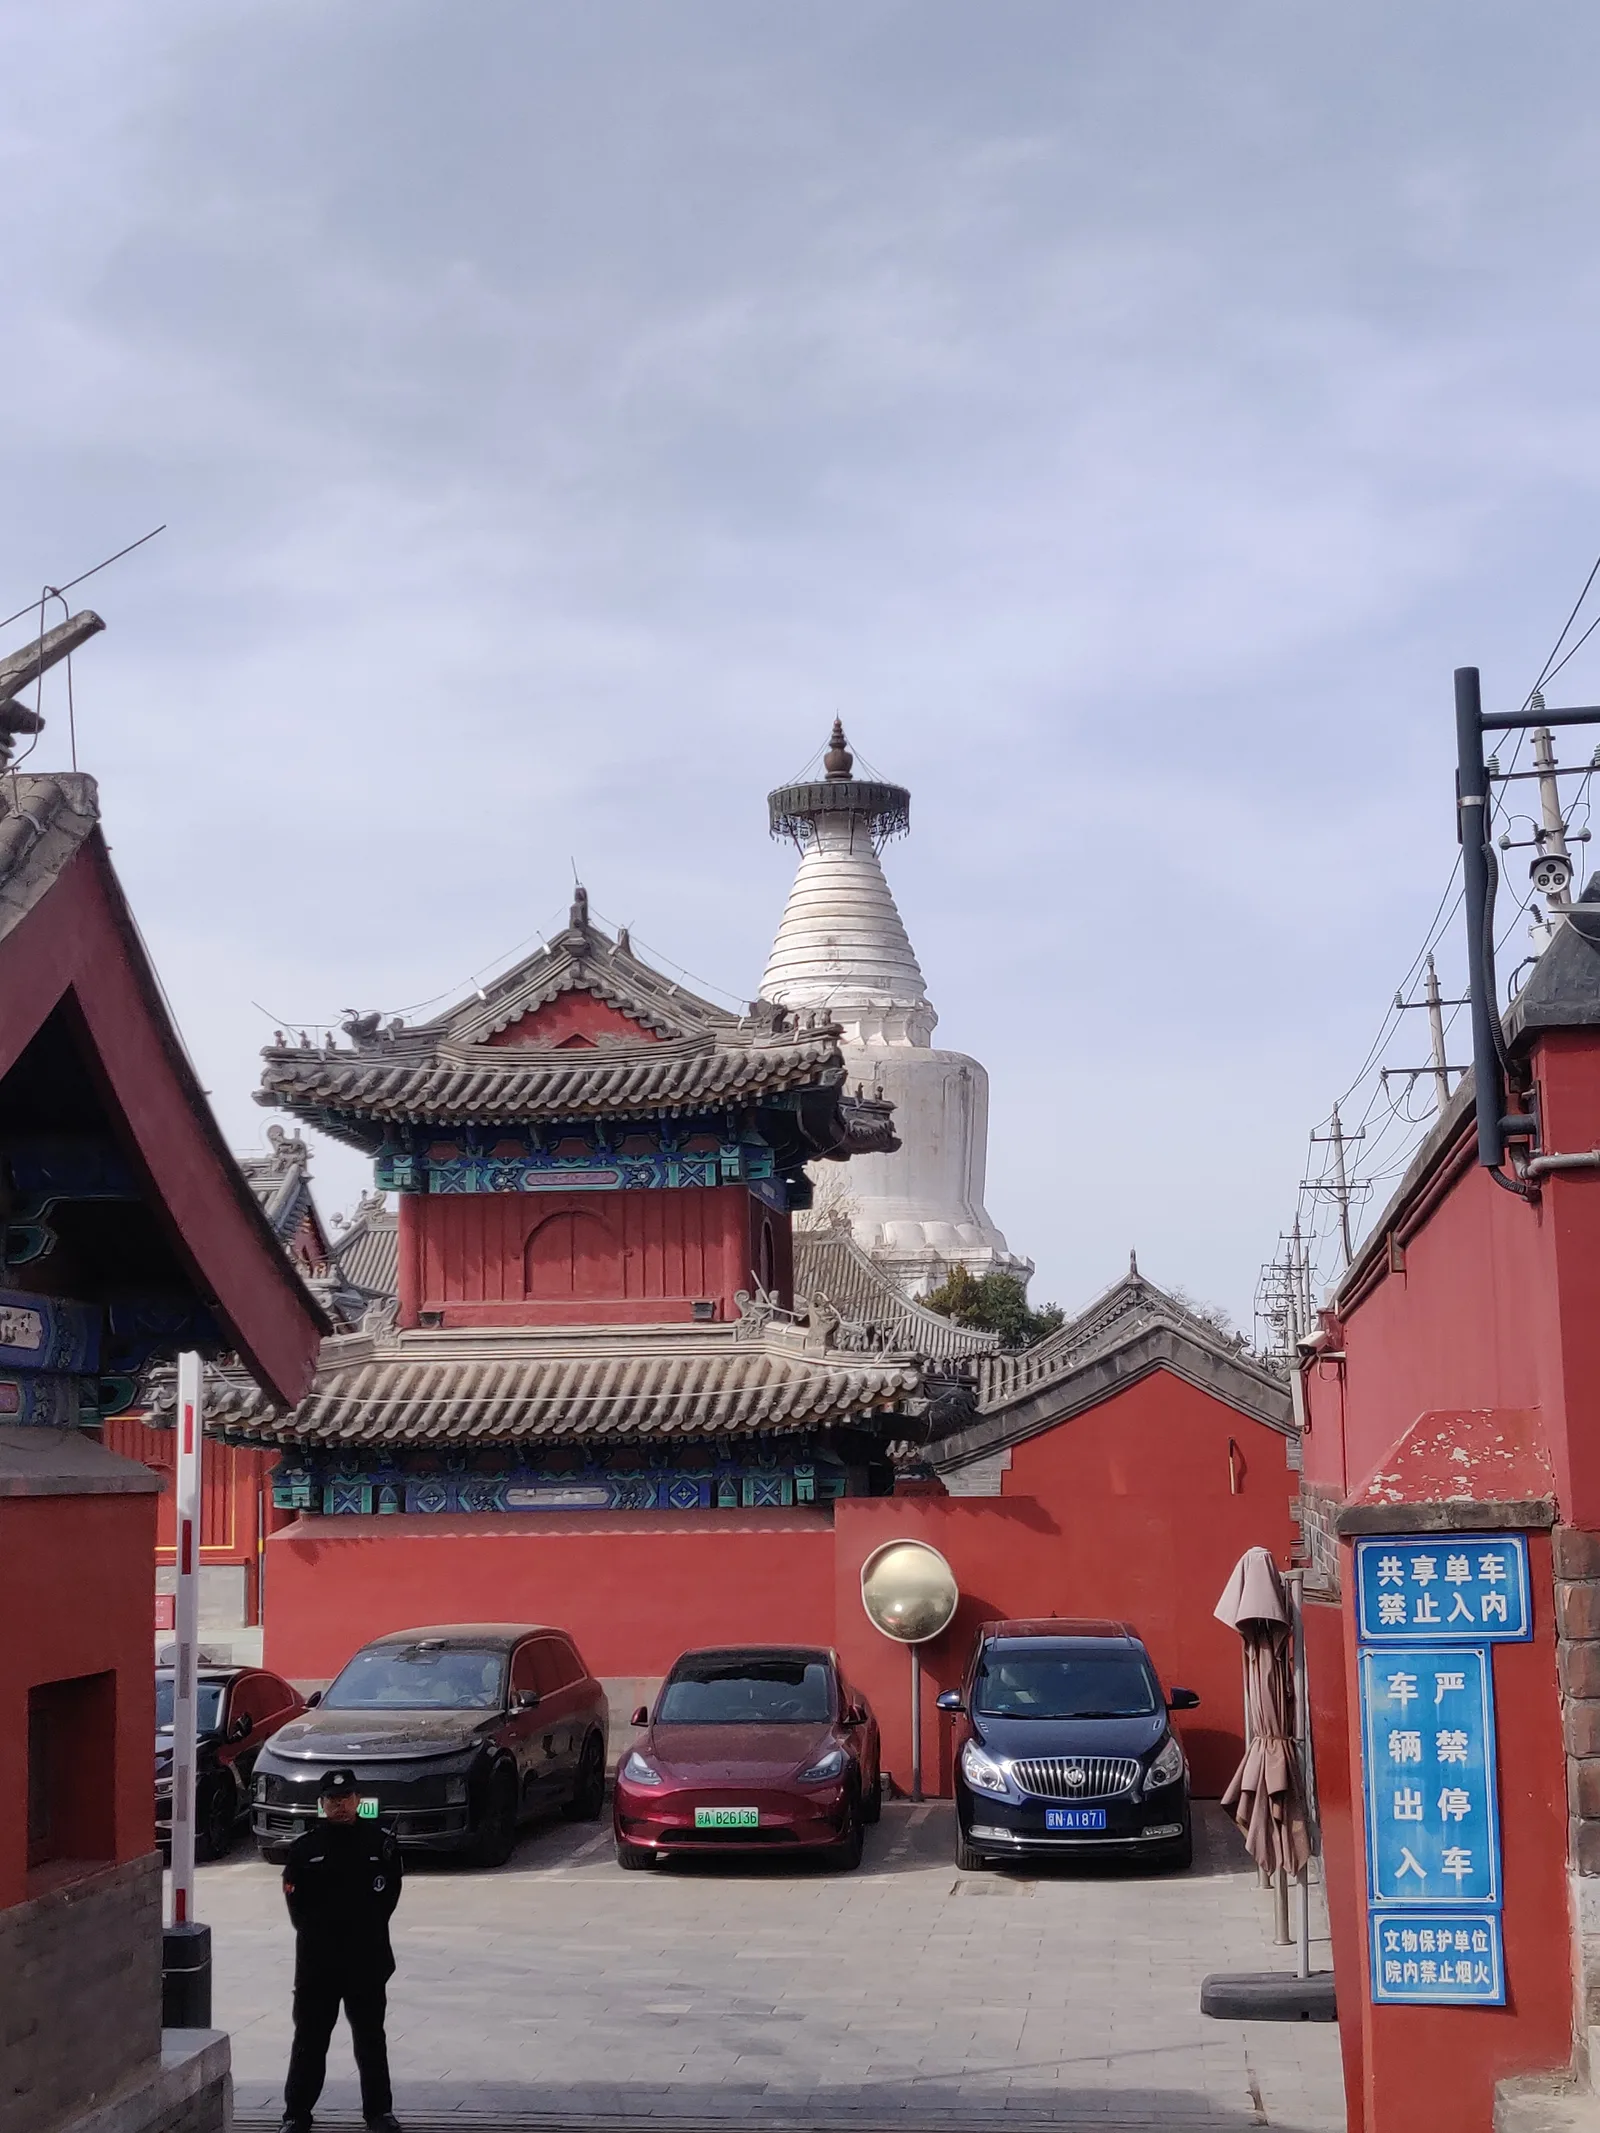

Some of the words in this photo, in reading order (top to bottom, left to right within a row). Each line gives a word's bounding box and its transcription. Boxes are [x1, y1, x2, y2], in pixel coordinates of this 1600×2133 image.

[1377, 1553, 1507, 1587] 共享单车
[1378, 1590, 1508, 1625] 禁止入内
[1387, 1672, 1428, 1879] 车辆出入
[1434, 1672, 1474, 1880] 严禁停车
[1383, 1929, 1489, 1953] 文物保护单位
[1385, 1959, 1491, 1984] 院内禁止烟火
